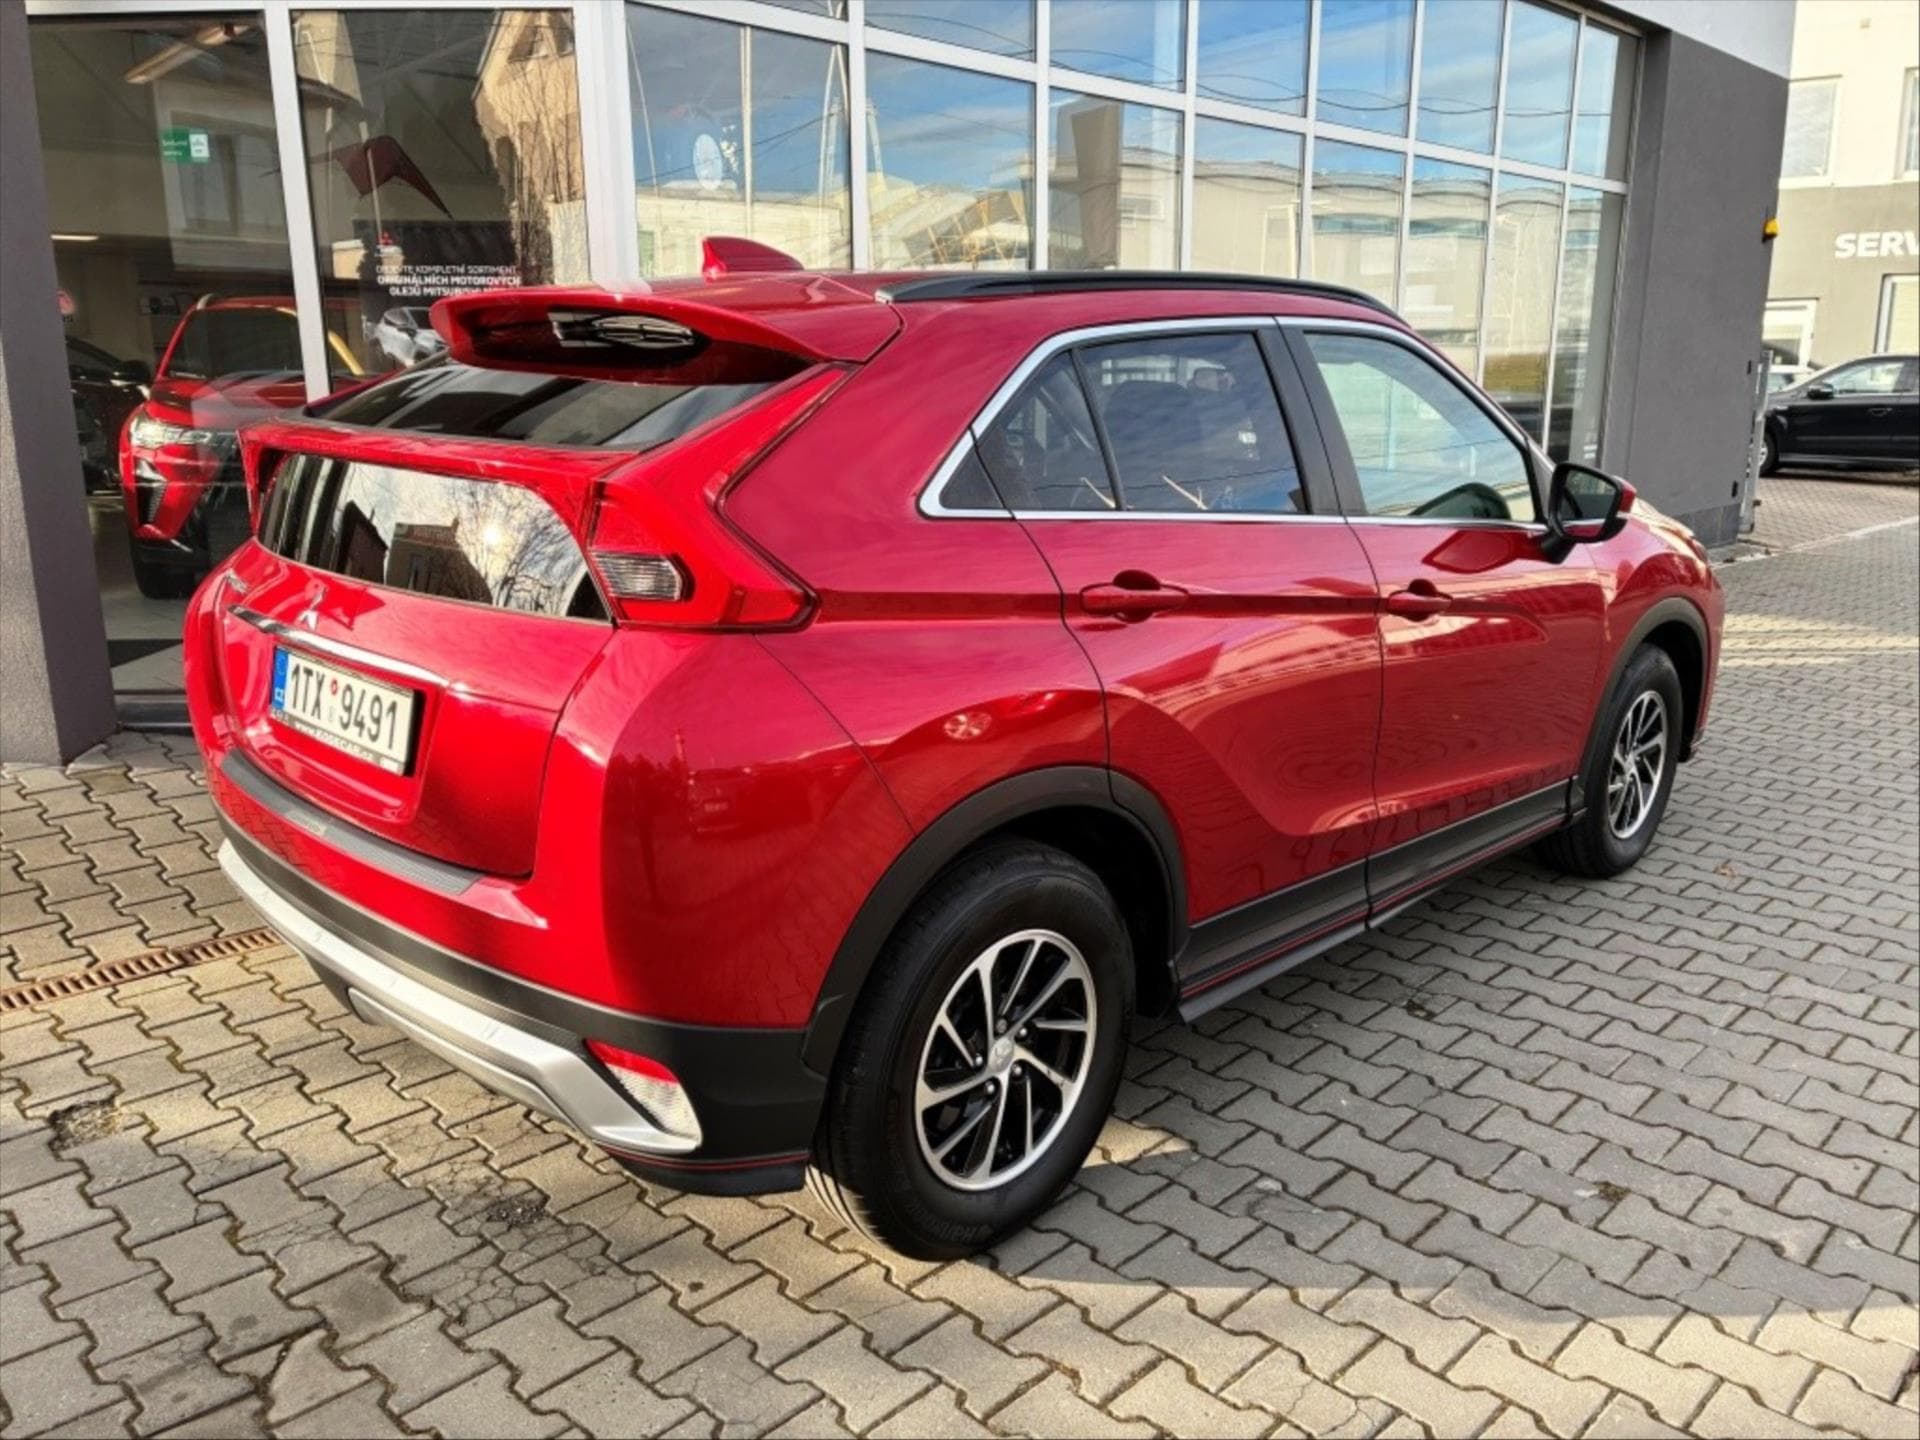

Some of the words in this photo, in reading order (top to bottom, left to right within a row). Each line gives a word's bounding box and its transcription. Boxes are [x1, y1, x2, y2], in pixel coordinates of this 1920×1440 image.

[1834, 230, 1919, 259] SERV
[292, 663, 326, 720] 1TX
[340, 684, 398, 750] 9491
